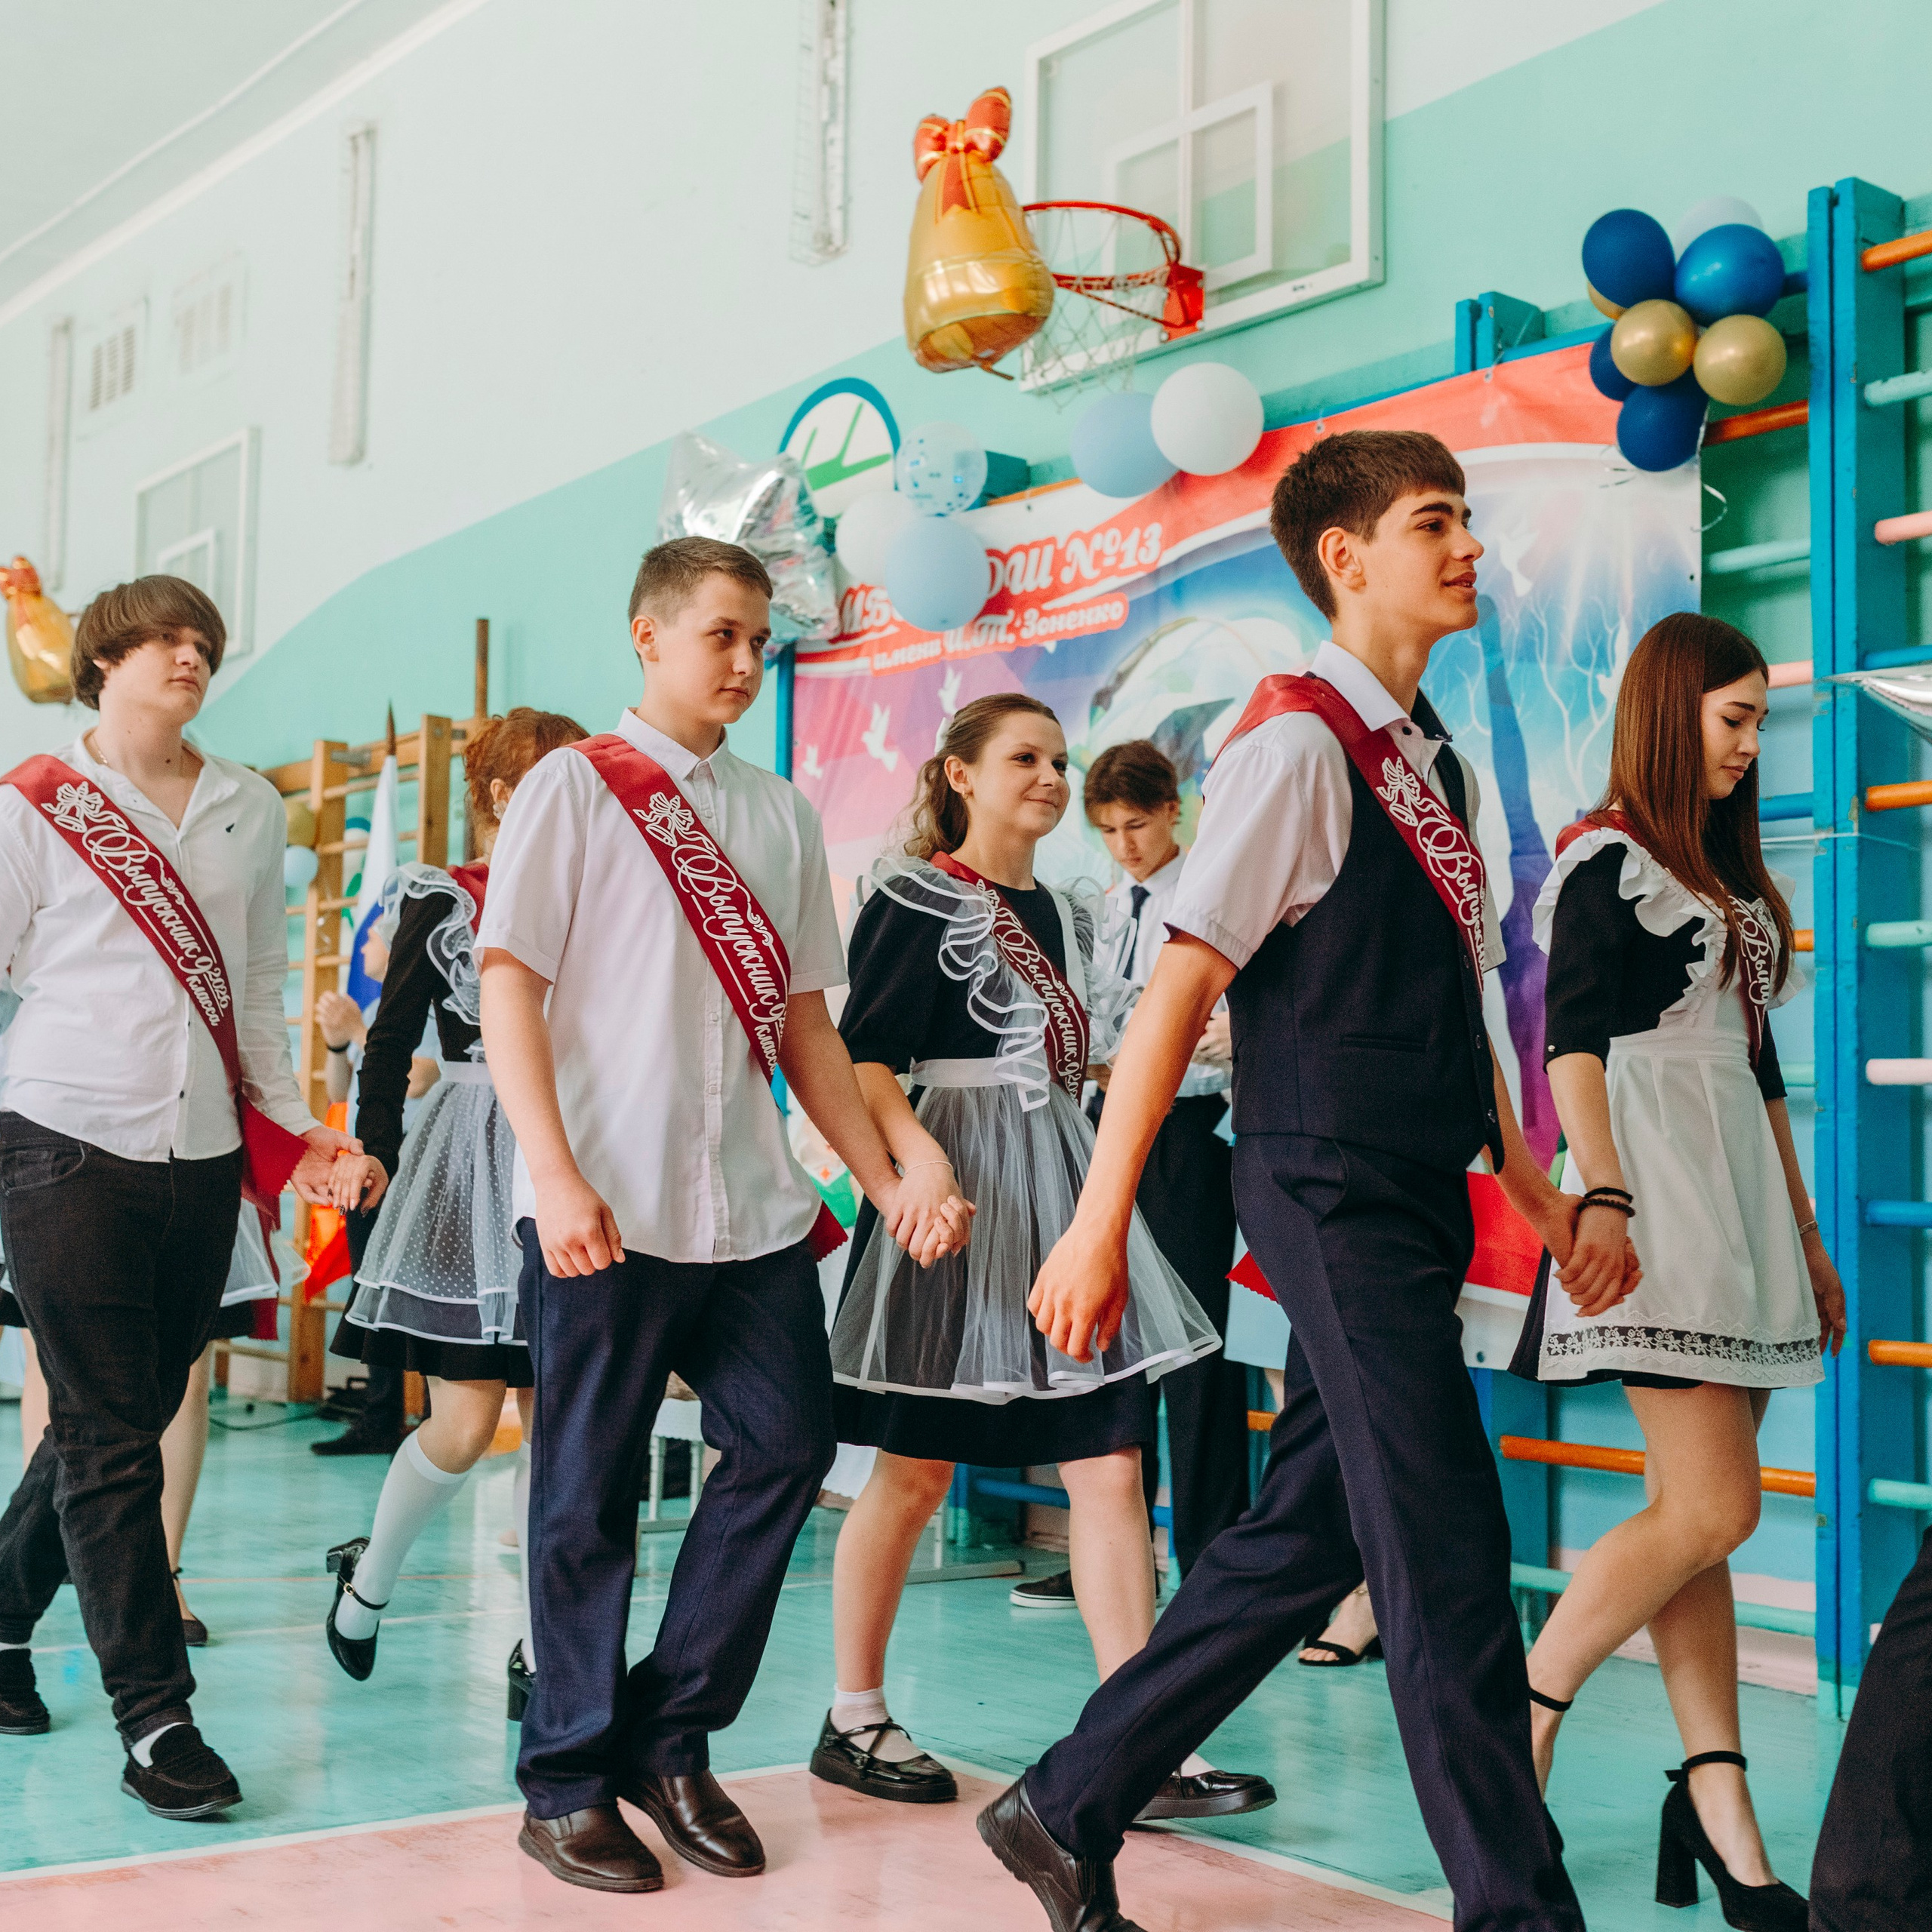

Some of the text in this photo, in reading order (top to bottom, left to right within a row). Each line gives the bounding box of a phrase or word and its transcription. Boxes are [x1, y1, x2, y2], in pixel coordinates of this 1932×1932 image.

[873, 638, 942, 669] имени
[1020, 601, 1124, 639] Зоненко
[82, 825, 202, 958] Выпускник
[671, 844, 780, 1006] Выпускник
[186, 975, 220, 1027] класса
[208, 968, 229, 1009] 2026
[991, 920, 1078, 1062] Выпускник
